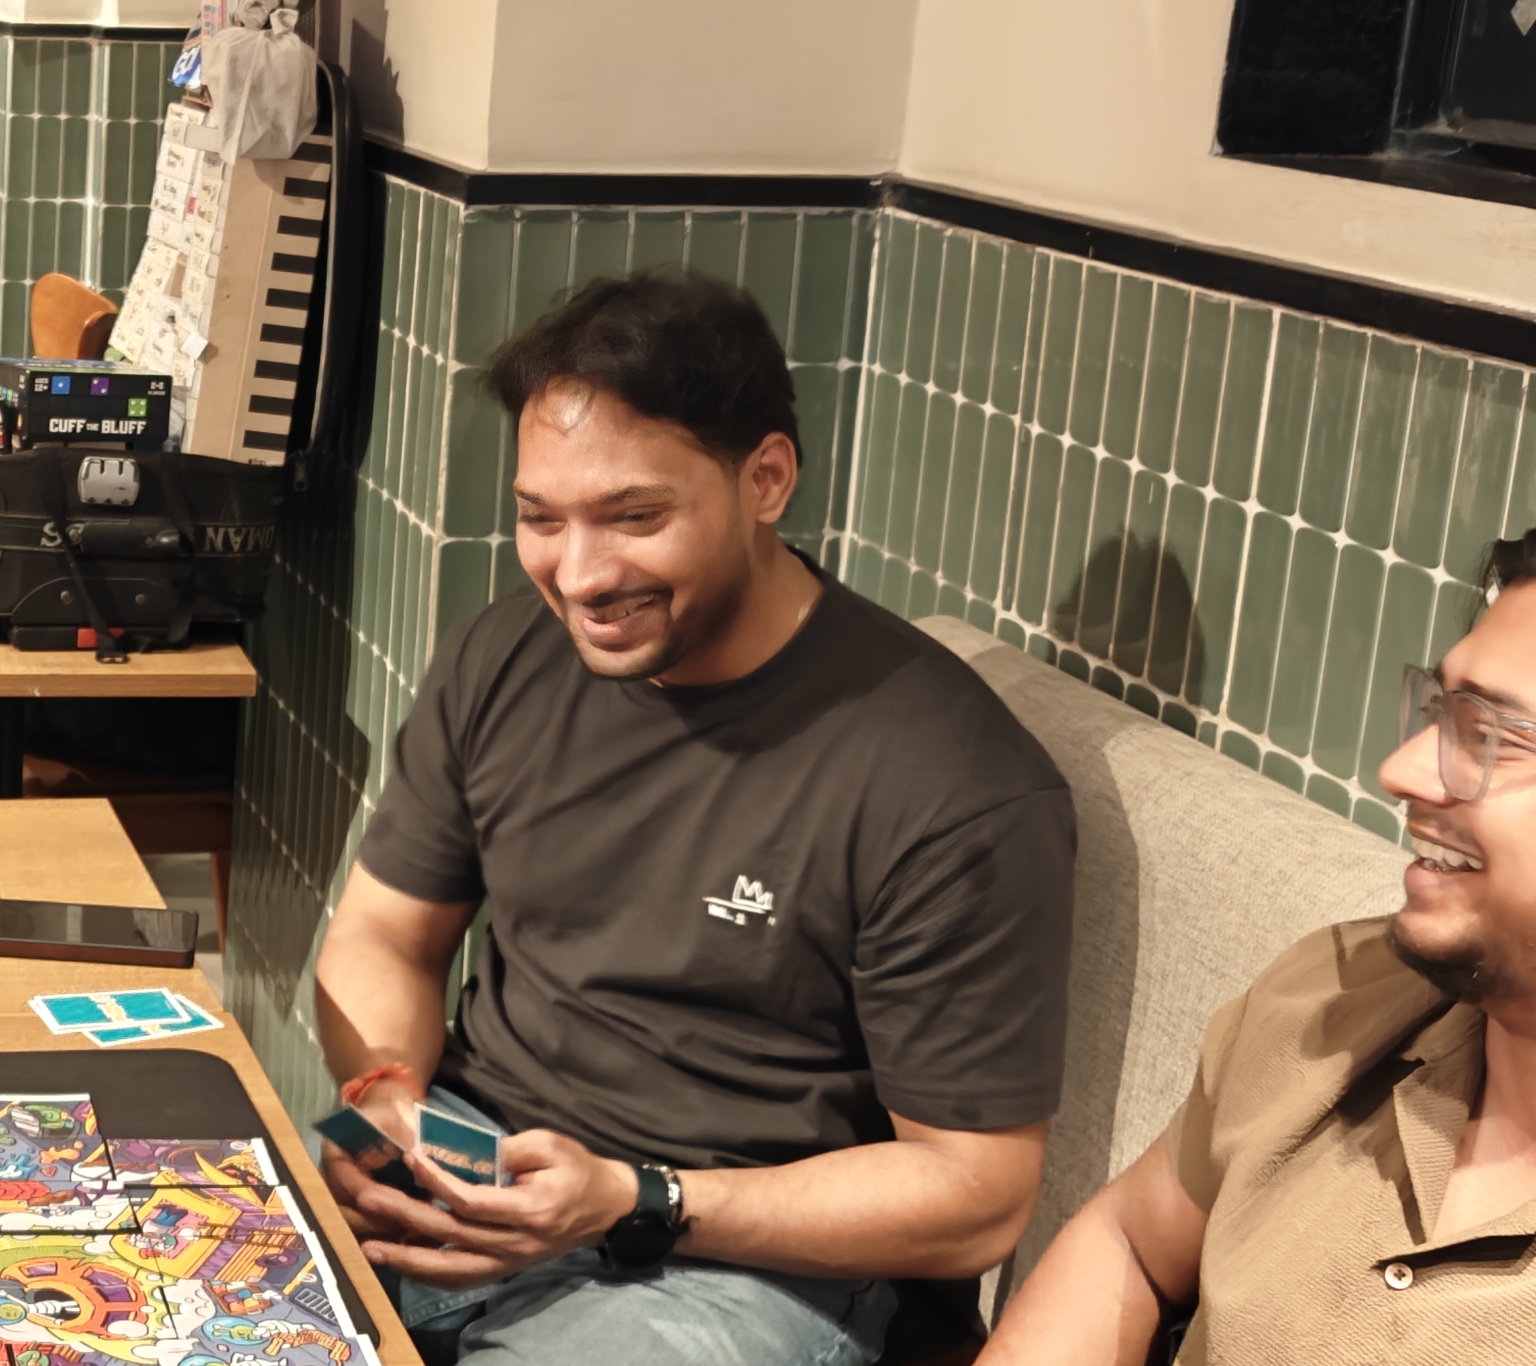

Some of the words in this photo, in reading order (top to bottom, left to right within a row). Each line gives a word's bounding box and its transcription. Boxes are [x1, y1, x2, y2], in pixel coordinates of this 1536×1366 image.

[48, 417, 87, 433] CUFF
[100, 419, 147, 435] BLUFF
[204, 524, 275, 552] OMAN
